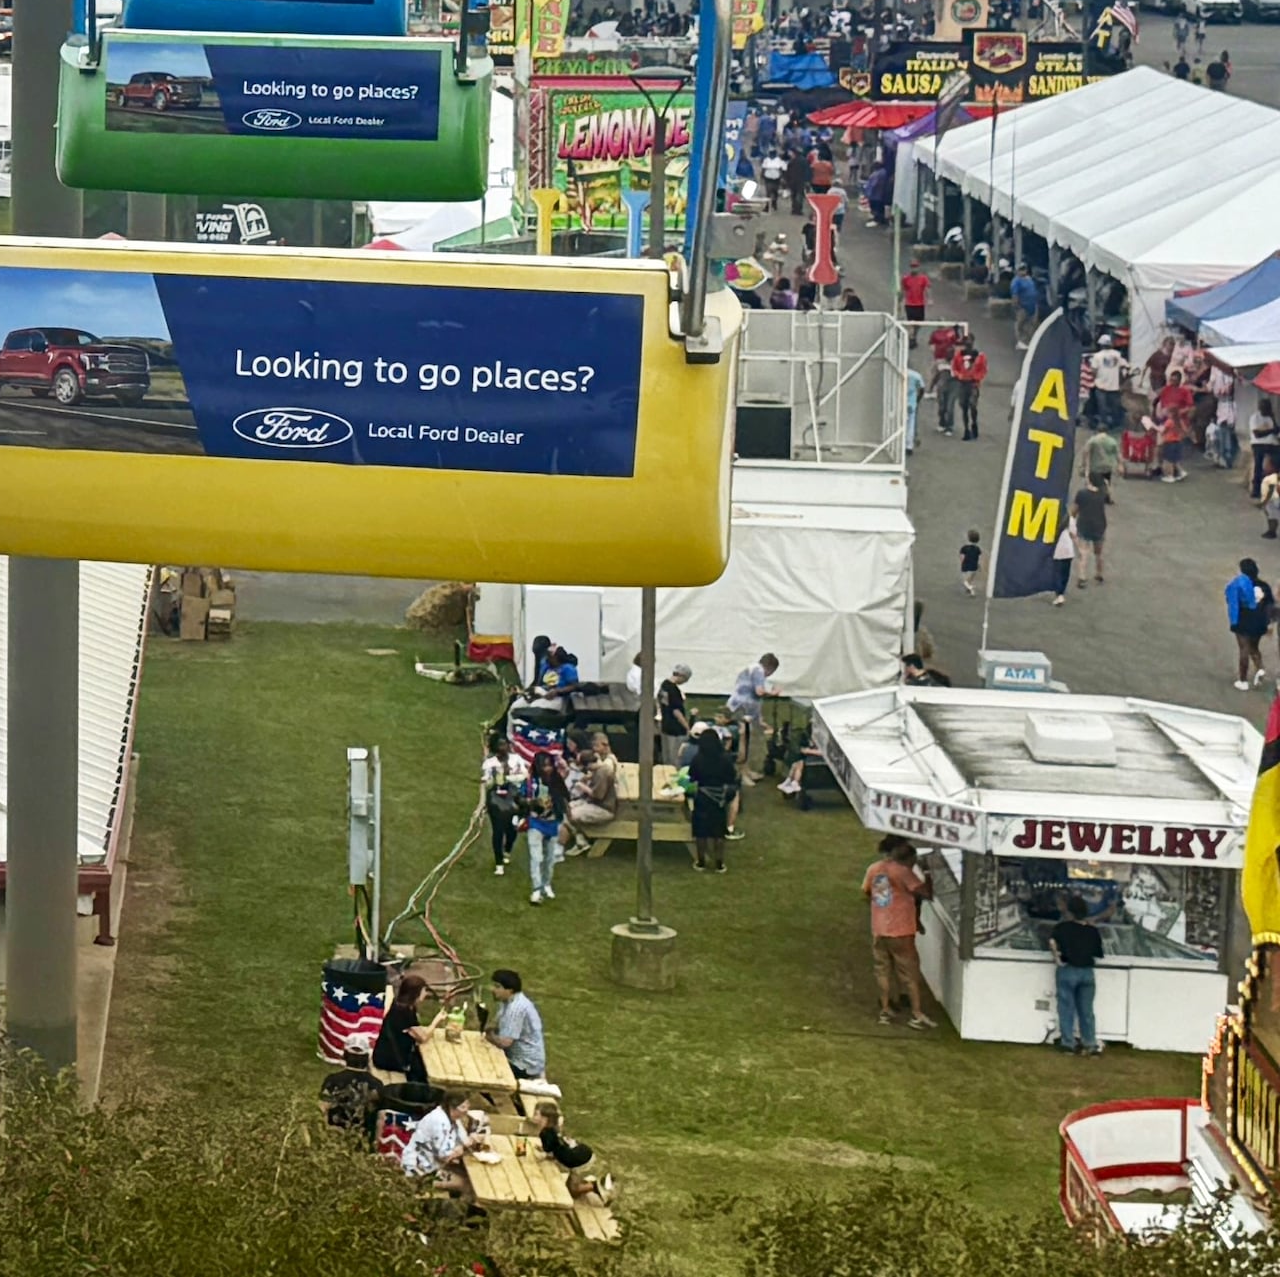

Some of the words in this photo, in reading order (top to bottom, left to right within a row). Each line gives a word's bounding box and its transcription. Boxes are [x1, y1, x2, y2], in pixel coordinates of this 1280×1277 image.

[243, 80, 307, 100] Looking
[311, 83, 329, 97] to
[332, 85, 354, 100] go
[358, 84, 419, 101] places?
[880, 73, 941, 94] SAUSA
[308, 115, 331, 125] Local
[333, 116, 353, 125] Ford
[557, 106, 691, 161] LEMONADE
[235, 349, 363, 388] Looking
[374, 356, 408, 384] to
[418, 364, 461, 391] go
[471, 361, 595, 393] places?
[368, 422, 413, 440] Local
[419, 425, 459, 442] Ford
[464, 427, 524, 445] Dealer
[1006, 368, 1070, 545] ATM
[1004, 666, 1036, 680] ATM
[871, 792, 977, 827] JEWELRY
[890, 813, 960, 842] GIFTS
[1012, 819, 1228, 860] JEWELRY
